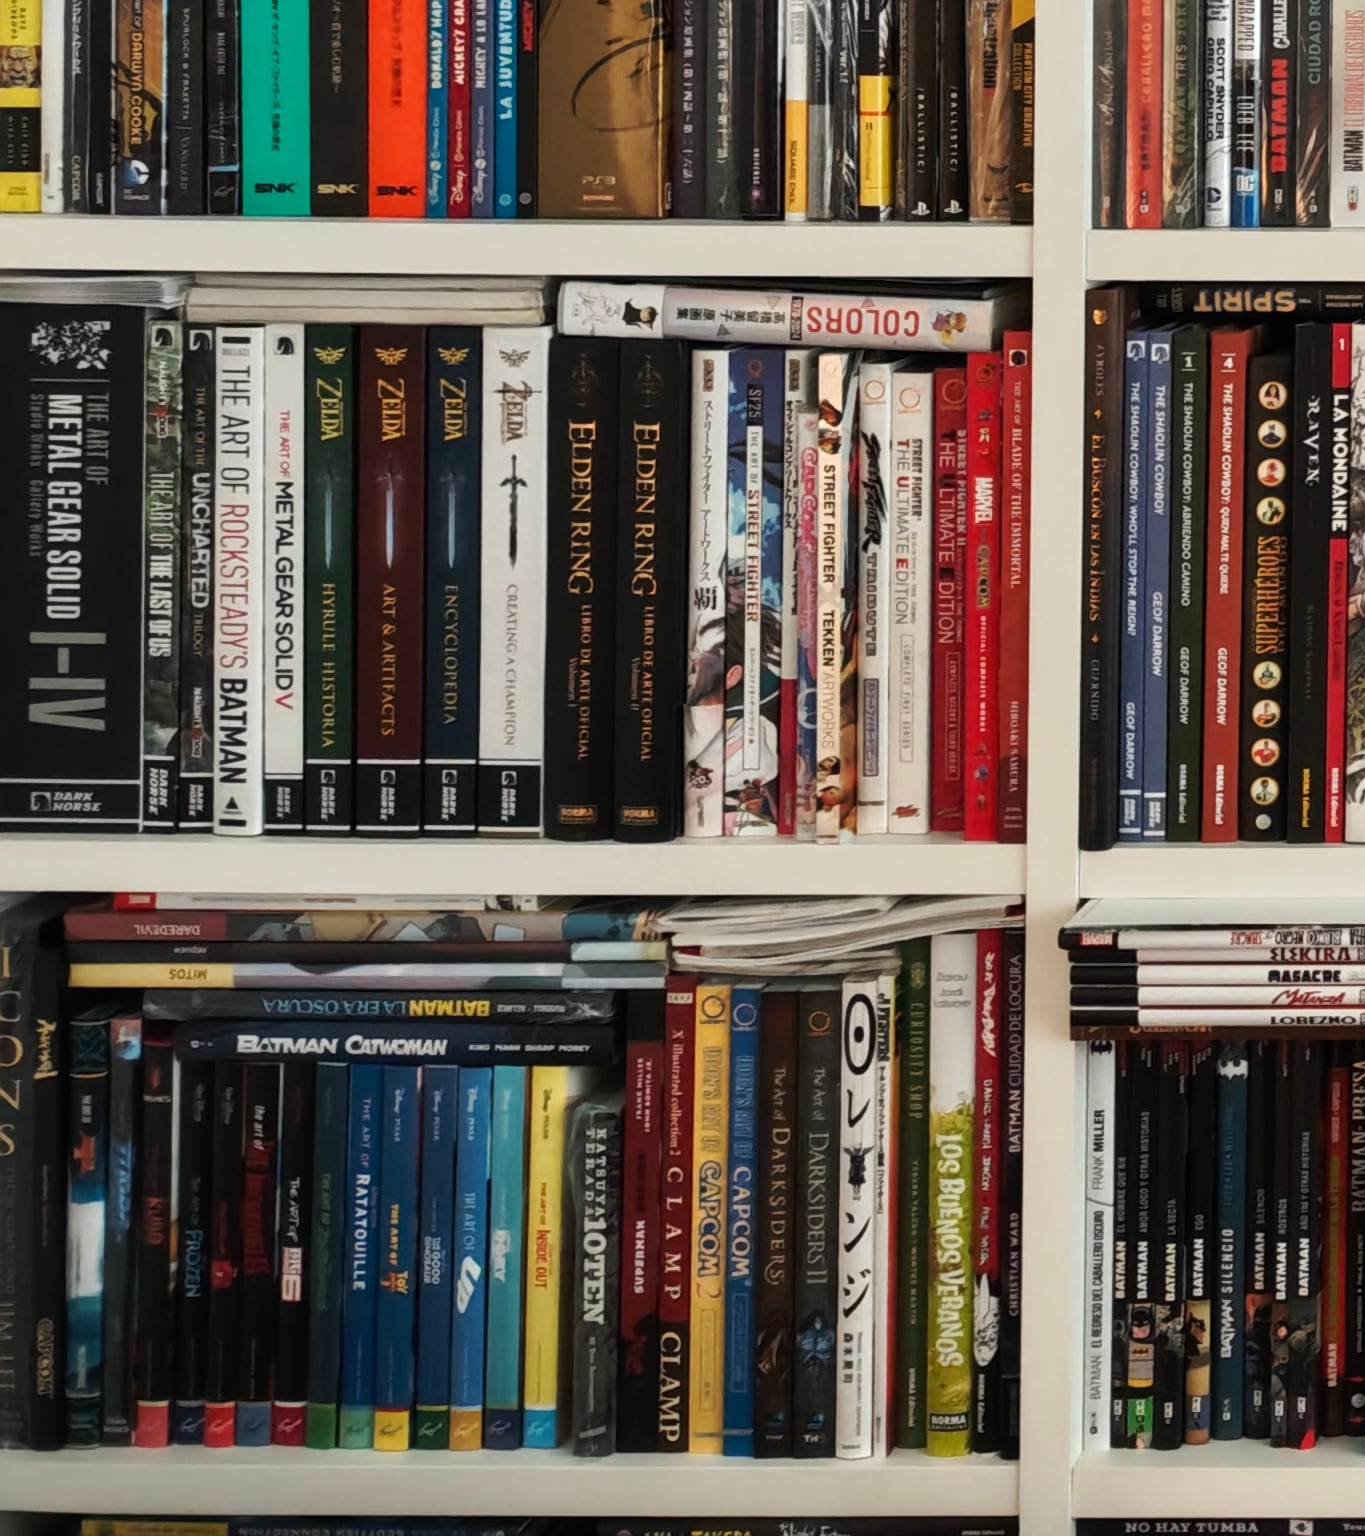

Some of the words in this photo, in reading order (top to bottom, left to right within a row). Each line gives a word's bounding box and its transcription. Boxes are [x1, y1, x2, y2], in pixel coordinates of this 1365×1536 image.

[254, 182, 295, 194] SNK
[807, 306, 920, 338] COLORS
[1194, 291, 1296, 313] SPIRIT
[221, 366, 251, 406] THE
[1334, 394, 1349, 420] LA
[48, 394, 83, 476] METAL
[220, 414, 251, 460] ART
[568, 420, 597, 514] ELDEN
[47, 482, 82, 544] GEAR
[220, 466, 250, 496] OF
[1332, 425, 1349, 532] MONDAINE
[47, 550, 81, 620] SOLID
[219, 503, 250, 670] ROCKSTEADY'S
[568, 521, 594, 596] RING
[321, 582, 336, 652] HYRULE
[219, 677, 249, 784] BATMAN
[320, 660, 334, 750] HISTORIA
[168, 968, 207, 980] MITOS
[237, 1035, 338, 1054] BATMAN
[345, 1036, 448, 1056] CATWOMAN
[936, 1134, 964, 1171] LOS
[353, 1174, 371, 1292] RATATOUILLE
[936, 1177, 967, 1263] BUENOS
[936, 1269, 965, 1368] VERANOS
[659, 1330, 682, 1443] CLAMP
[1125, 1522, 1151, 1533] NO
[1155, 1522, 1190, 1534] HAY
[1195, 1522, 1259, 1534] TUMBA
